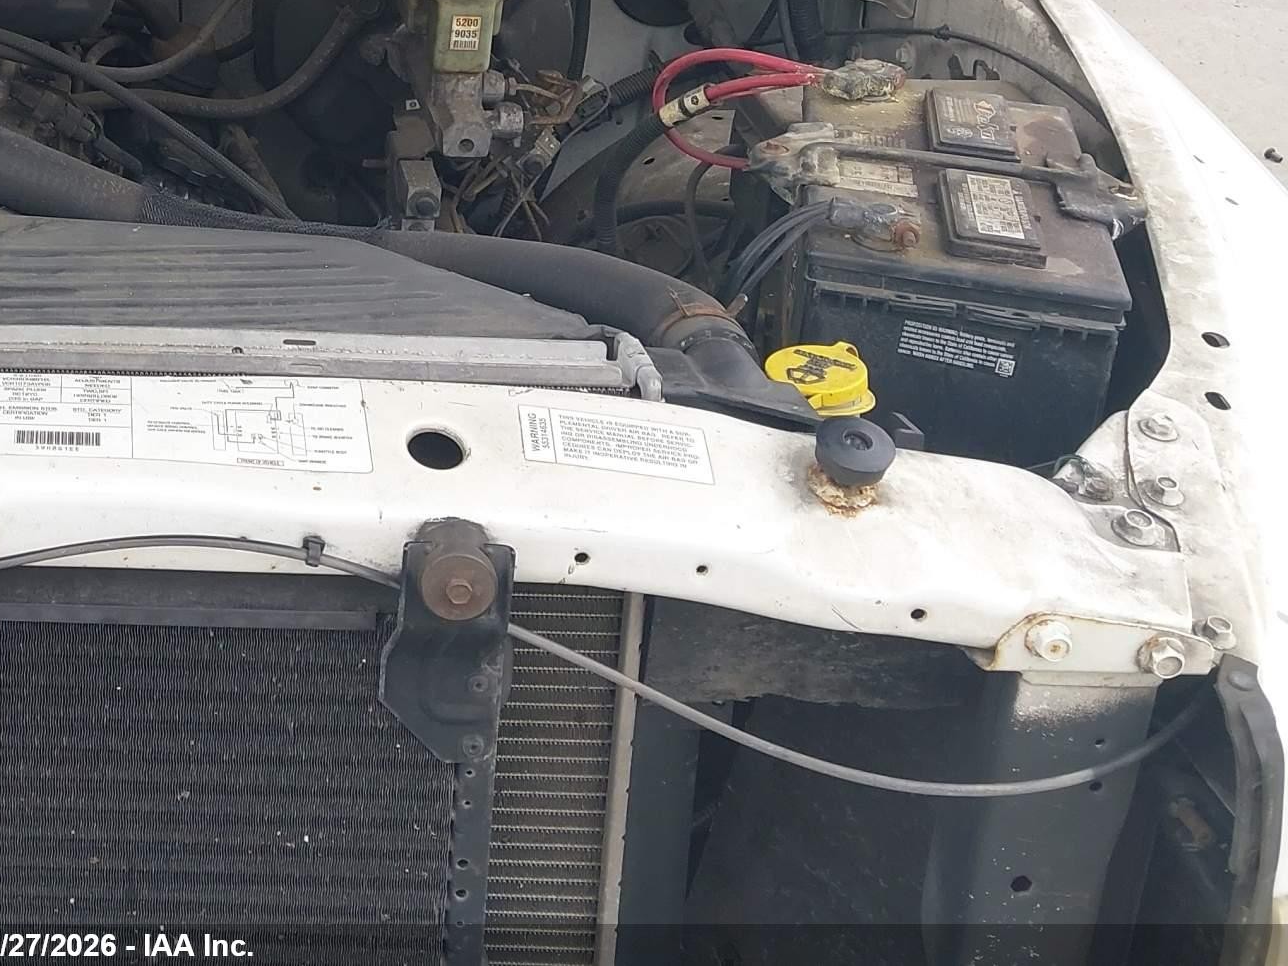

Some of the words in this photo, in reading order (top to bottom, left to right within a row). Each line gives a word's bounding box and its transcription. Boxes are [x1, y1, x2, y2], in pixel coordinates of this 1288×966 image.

[456, 18, 478, 28] 5200
[455, 30, 477, 38] 9035
[528, 413, 540, 452] WARNING
